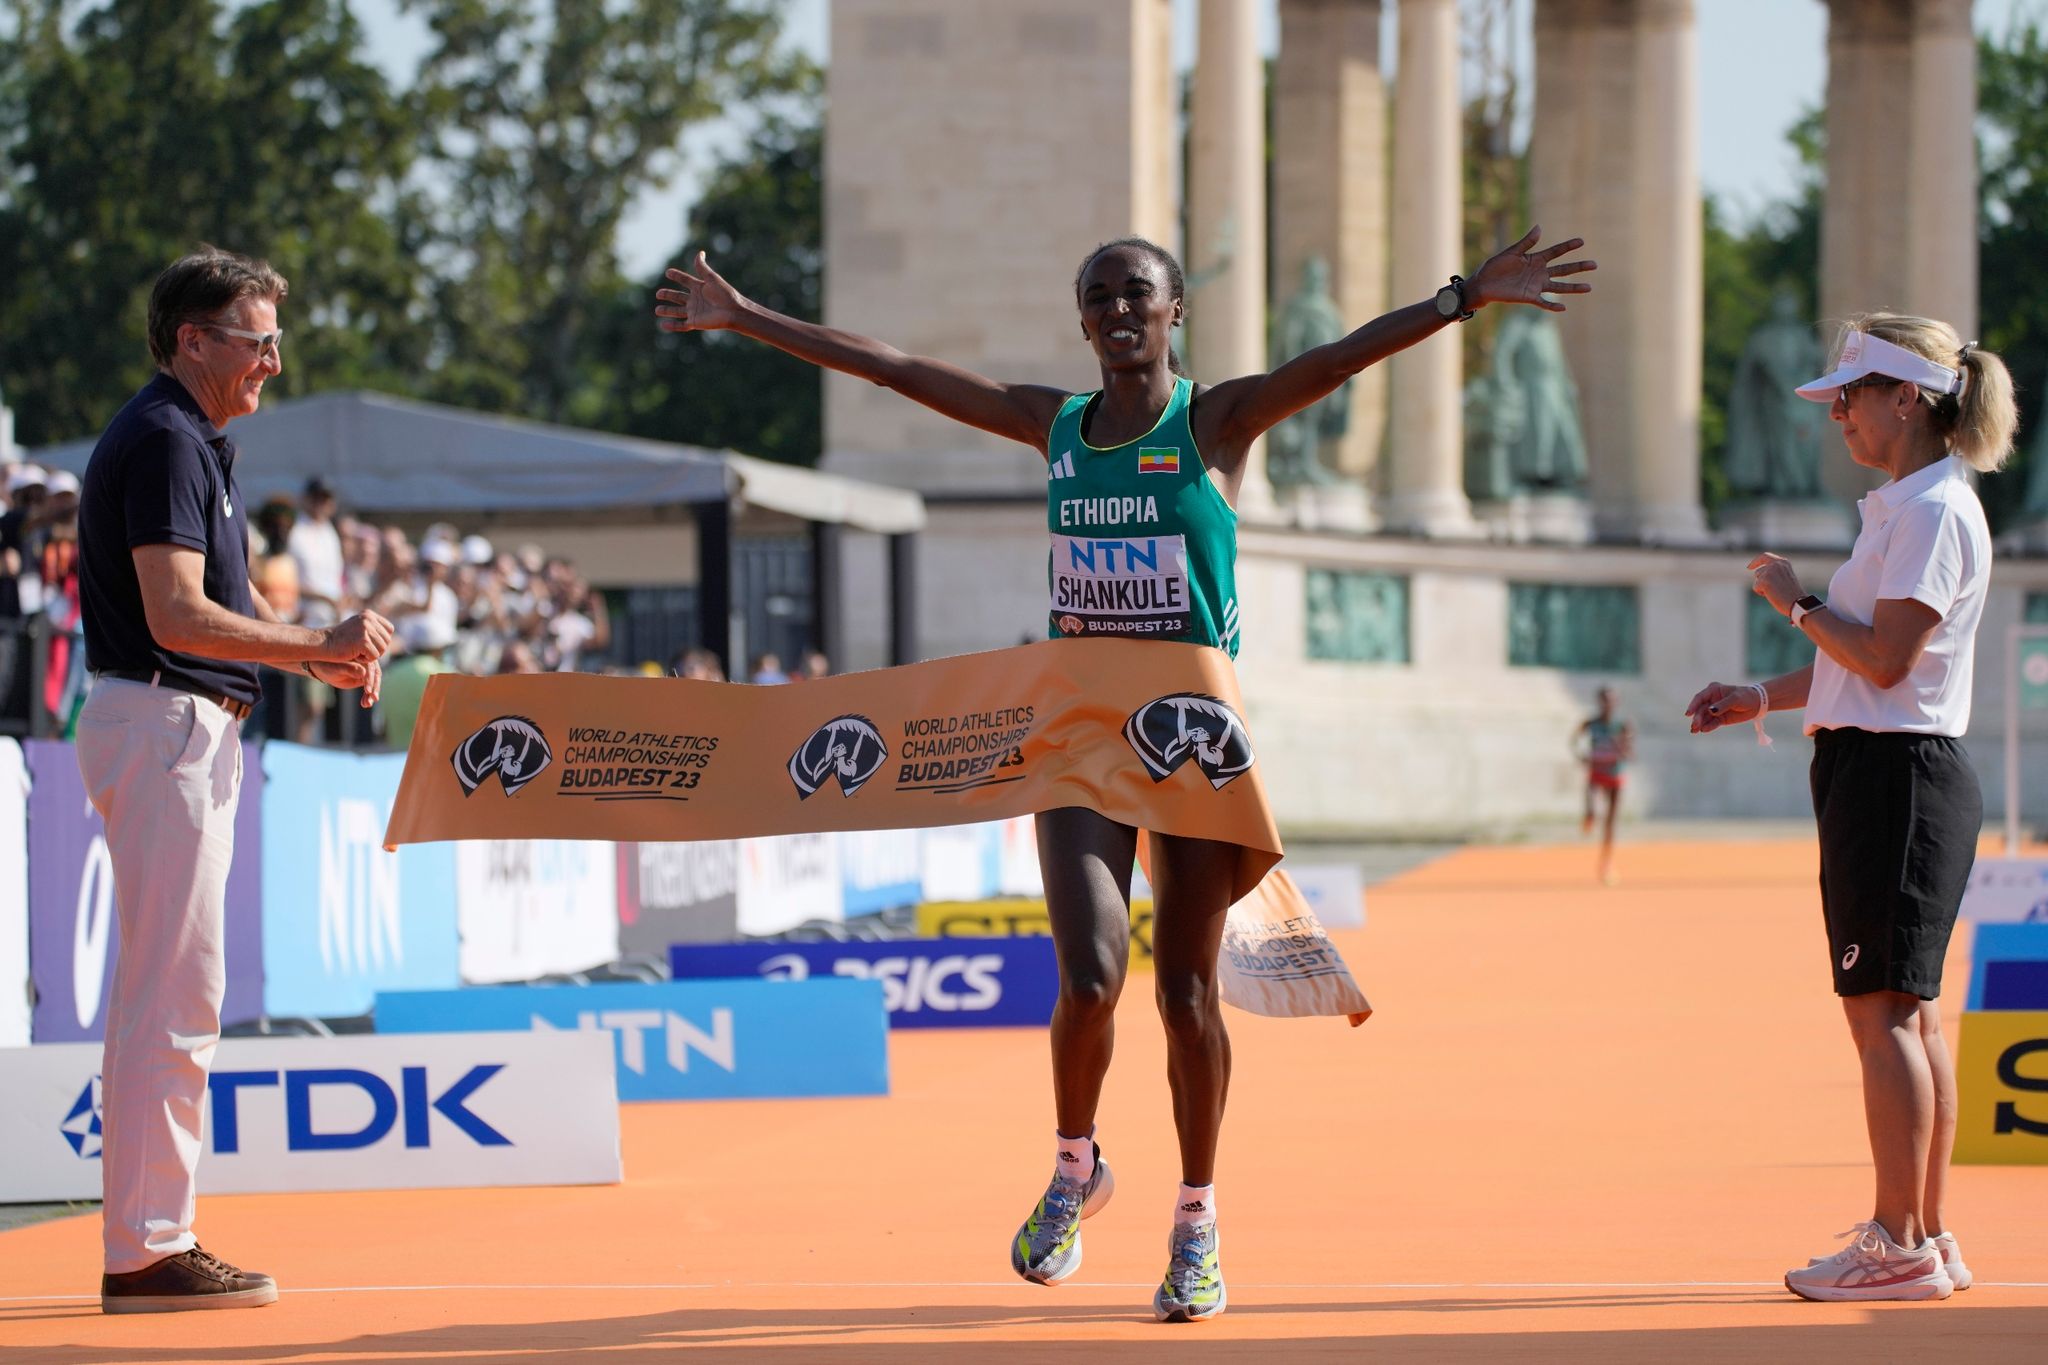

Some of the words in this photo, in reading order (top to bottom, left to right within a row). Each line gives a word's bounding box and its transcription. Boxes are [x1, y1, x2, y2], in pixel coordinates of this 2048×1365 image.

[1060, 496, 1159, 526] ETHIOPIA
[1070, 539, 1158, 575] NTN
[1058, 576, 1182, 610] SHANKULE
[1088, 620, 1162, 632] BUDAPEST
[1165, 619, 1182, 631] 23
[904, 717, 958, 737] WORLD
[960, 706, 1034, 732] ATHLETICS
[568, 727, 627, 744] WORLD
[627, 732, 719, 751] ATHLETICS
[902, 726, 1029, 759] CHAMPIONSHIPS
[564, 747, 710, 768] CHAMPIONSHIPS
[898, 751, 1000, 783] BUDAPEST
[998, 745, 1025, 768] 23
[560, 768, 671, 788] BUDAPEST
[670, 771, 701, 789] 23
[1228, 948, 1328, 971] BUDAPEST
[204, 1064, 515, 1154] TDK
